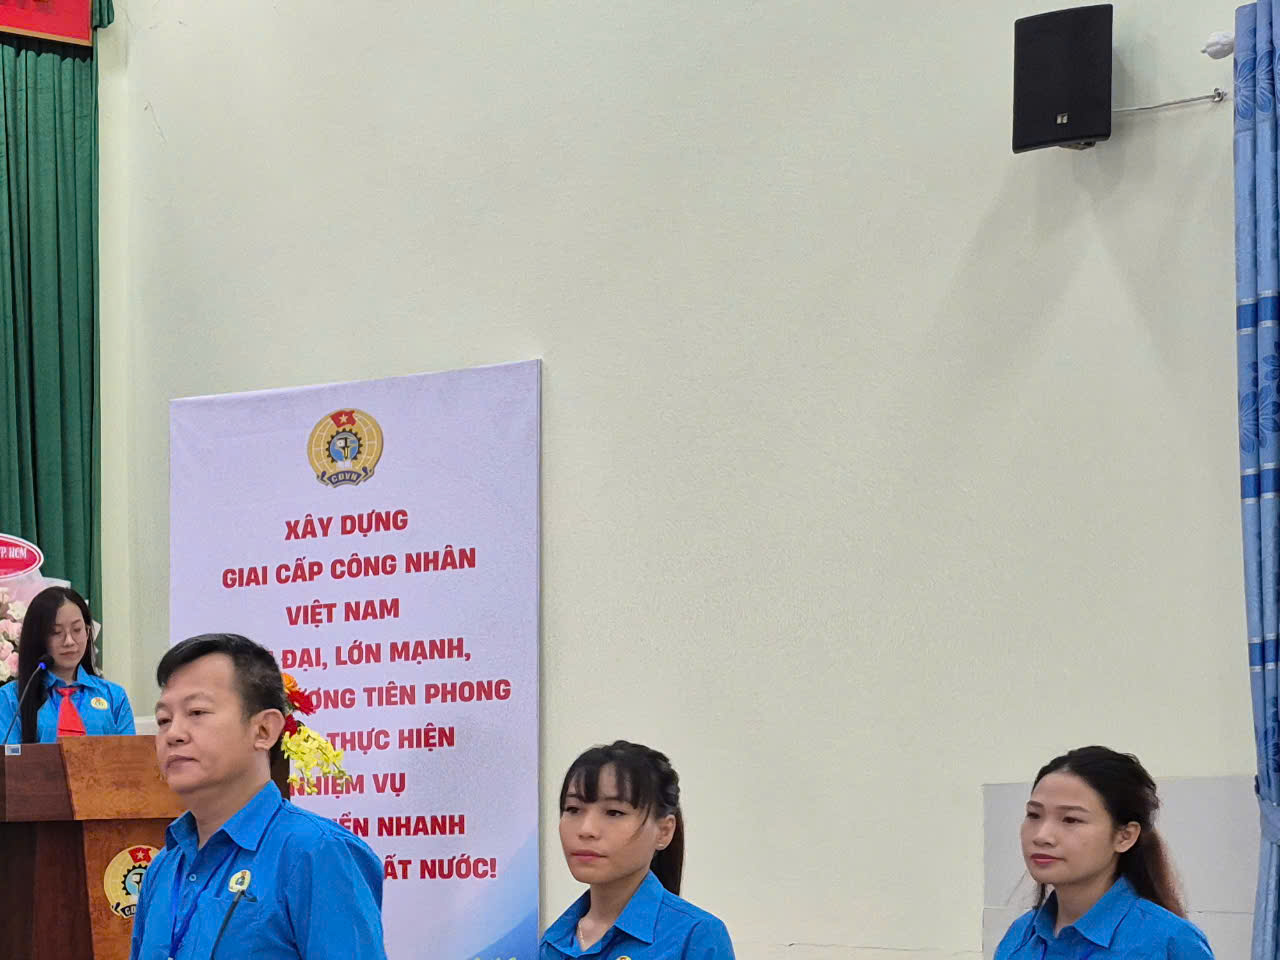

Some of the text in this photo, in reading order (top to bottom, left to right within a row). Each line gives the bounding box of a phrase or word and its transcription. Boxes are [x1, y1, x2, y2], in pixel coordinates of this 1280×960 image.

[285, 509, 409, 541] XÂY DỰNG
[222, 544, 476, 589] GIAI CẤP CÔNG NHÂN
[286, 598, 400, 628] VIỆT NAM
[281, 637, 471, 672] ĐẠI, LỚN MẠNH,
[363, 680, 416, 707] TIÊN
[424, 679, 511, 704] PHONG
[326, 722, 455, 755] THỰC HIỆN
[372, 772, 406, 797] VỤ
[377, 814, 465, 837] NHANH
[384, 854, 496, 880] ẤT NƯỚC!
